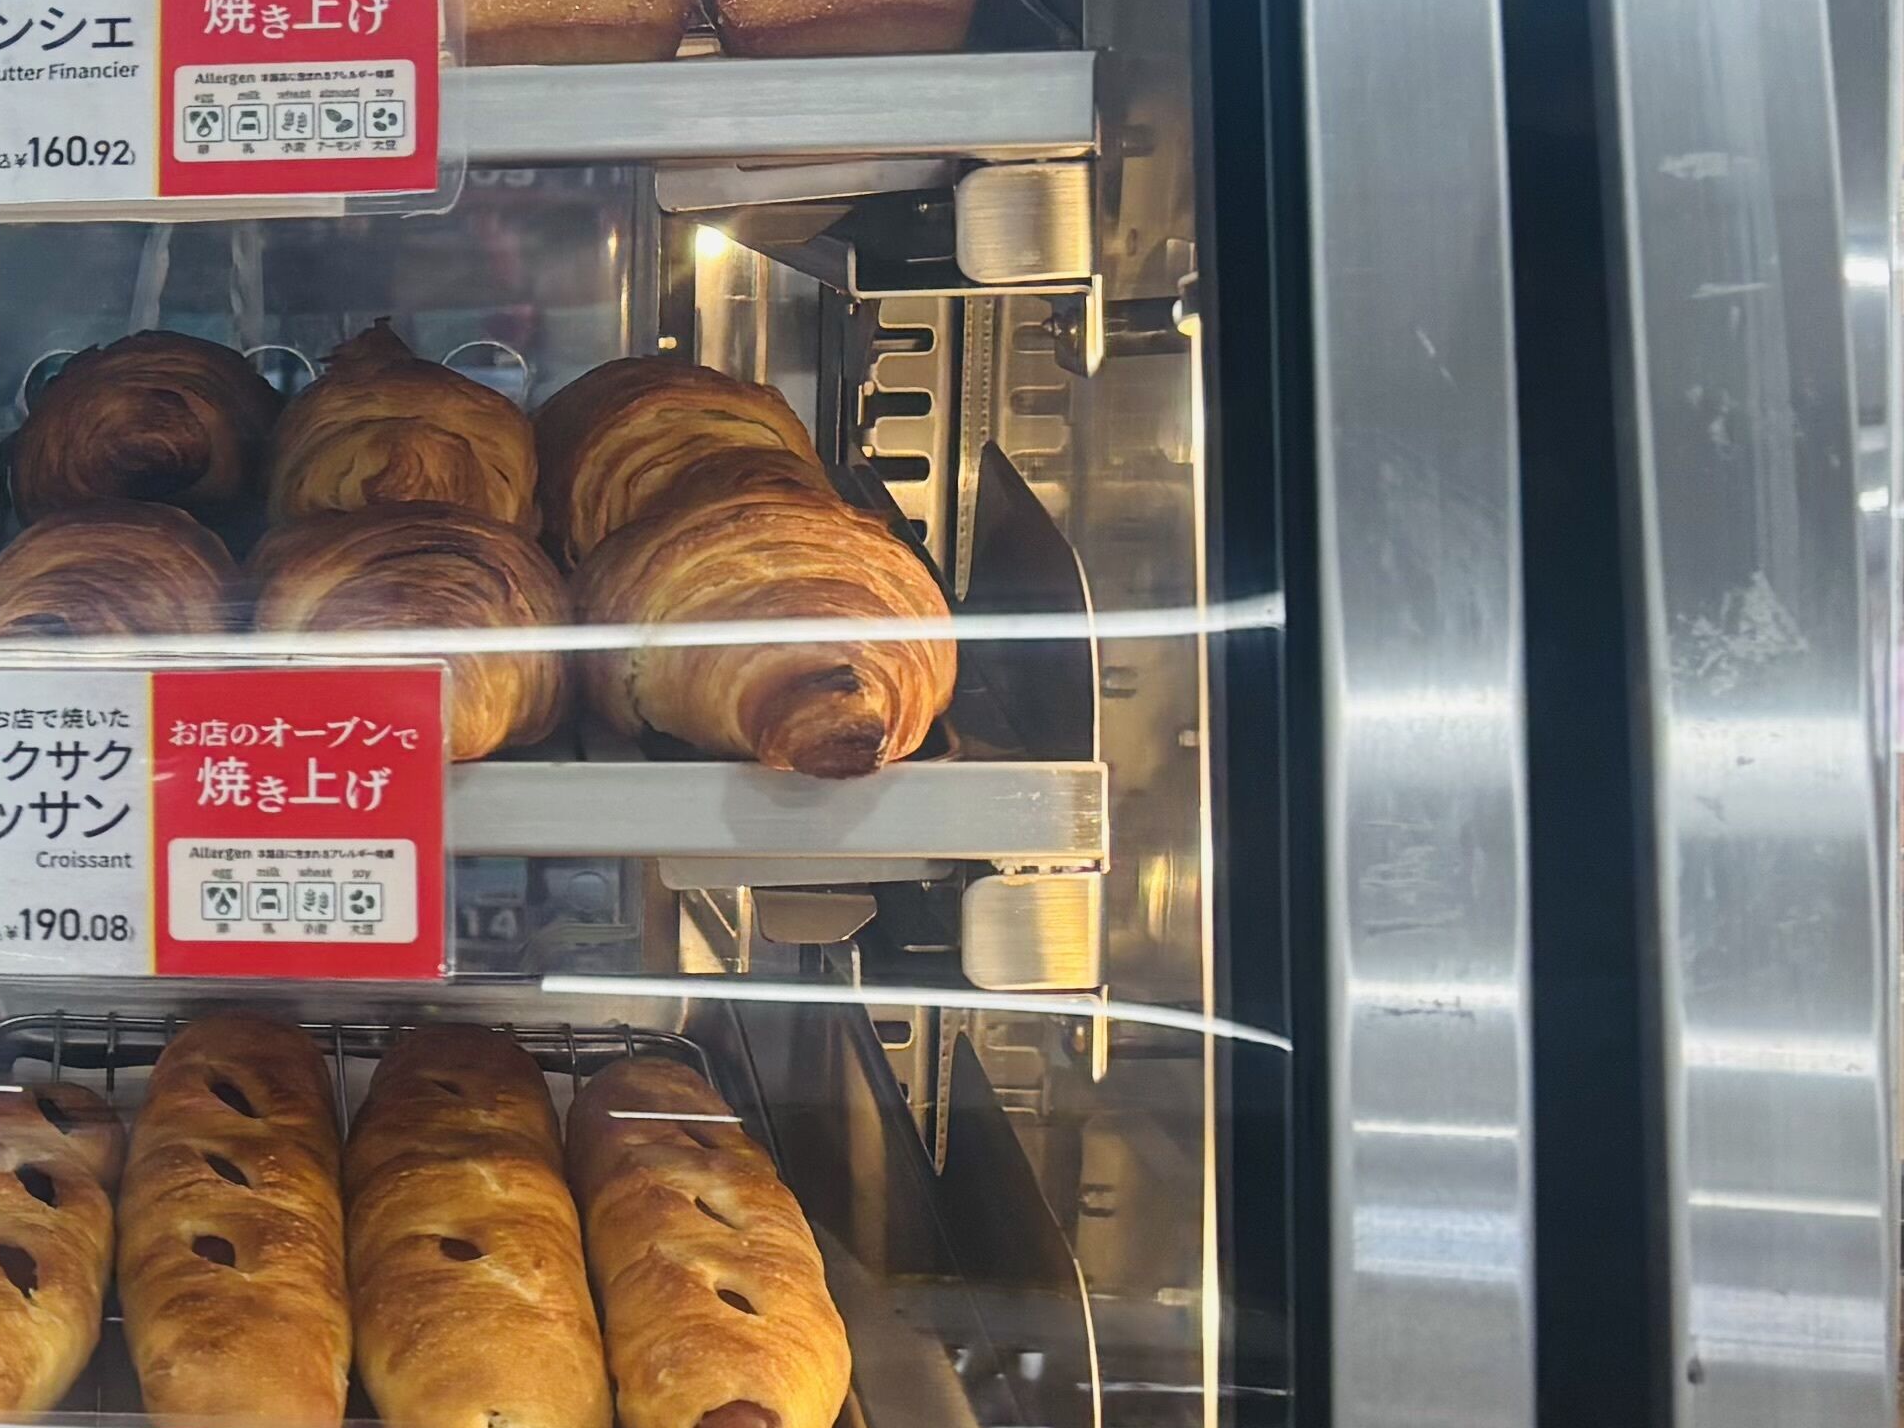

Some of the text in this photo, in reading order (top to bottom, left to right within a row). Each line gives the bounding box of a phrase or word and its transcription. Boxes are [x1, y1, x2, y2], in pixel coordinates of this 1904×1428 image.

[49, 61, 140, 81] Financier
[169, 716, 419, 750] お店のオーブンで
[196, 756, 390, 813] 焼き上げ
[35, 848, 132, 871] Croissant
